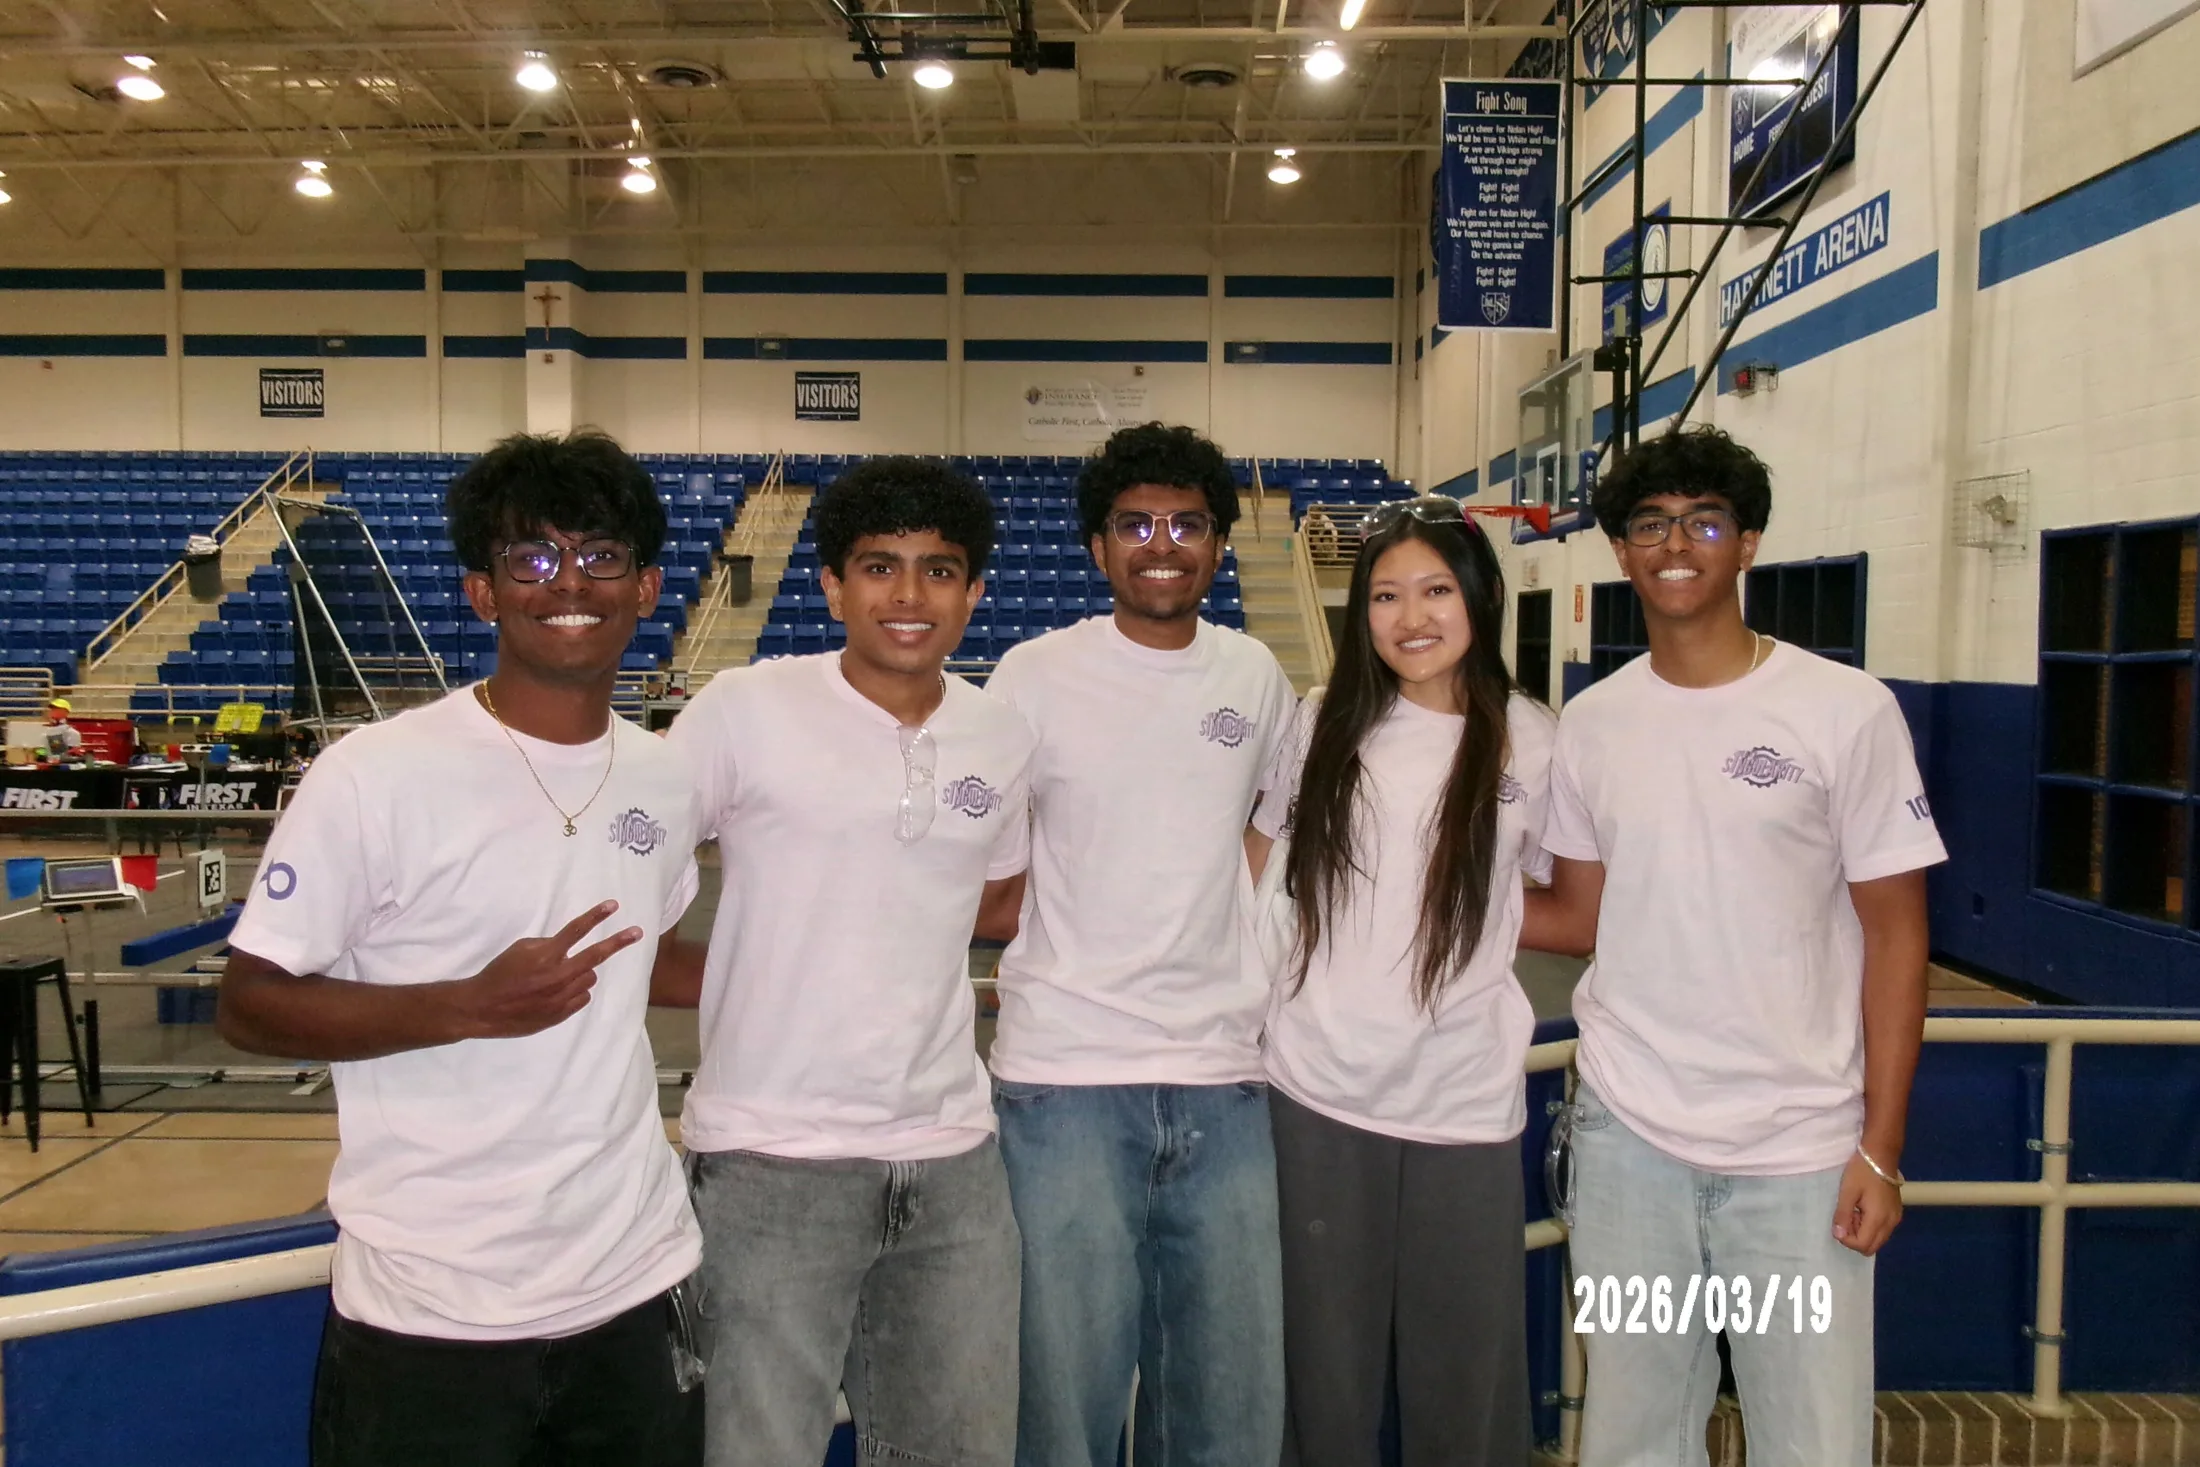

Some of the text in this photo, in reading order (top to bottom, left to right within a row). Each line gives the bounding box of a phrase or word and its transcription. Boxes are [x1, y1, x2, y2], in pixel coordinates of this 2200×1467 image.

[1476, 91, 1527, 114] Fight Song
[1458, 124, 1474, 133] Let's
[1476, 125, 1494, 133] cheer
[1496, 125, 1506, 133] for
[1464, 134, 1472, 143] all
[1473, 134, 1481, 143] be
[1483, 135, 1497, 144] true
[1499, 135, 1506, 144] to
[1507, 135, 1528, 144] White
[1529, 136, 1541, 144] and
[1459, 144, 1543, 156] For we are Vikings strong
[1733, 131, 1754, 164] HOME
[1464, 155, 1478, 164] And
[1479, 156, 1504, 166] through
[1519, 157, 1536, 167] might
[1490, 166, 1502, 175] win
[1479, 182, 1519, 193] Fight! Fight!
[1479, 193, 1519, 204] Fight! Fight!
[1460, 208, 1477, 218] Fight
[1489, 209, 1499, 217] for
[1468, 220, 1487, 229] gonna
[1489, 220, 1501, 228] win
[1503, 220, 1515, 228] and
[1517, 220, 1530, 228] win
[1450, 228, 1462, 238] Our
[1480, 229, 1492, 238] will
[1493, 230, 1509, 239] have
[1511, 231, 1519, 239] no
[1814, 201, 1884, 276] ARENA
[1492, 241, 1511, 250] gonna
[1471, 251, 1480, 259] On
[1482, 251, 1493, 259] the
[1476, 266, 1517, 277] Fight! Fight!
[1476, 277, 1516, 288] Fight! Fight!
[262, 380, 323, 405] VISITORS
[797, 383, 859, 409] VISITORS
[179, 782, 257, 804] FIRST
[2, 787, 79, 811] FIRST
